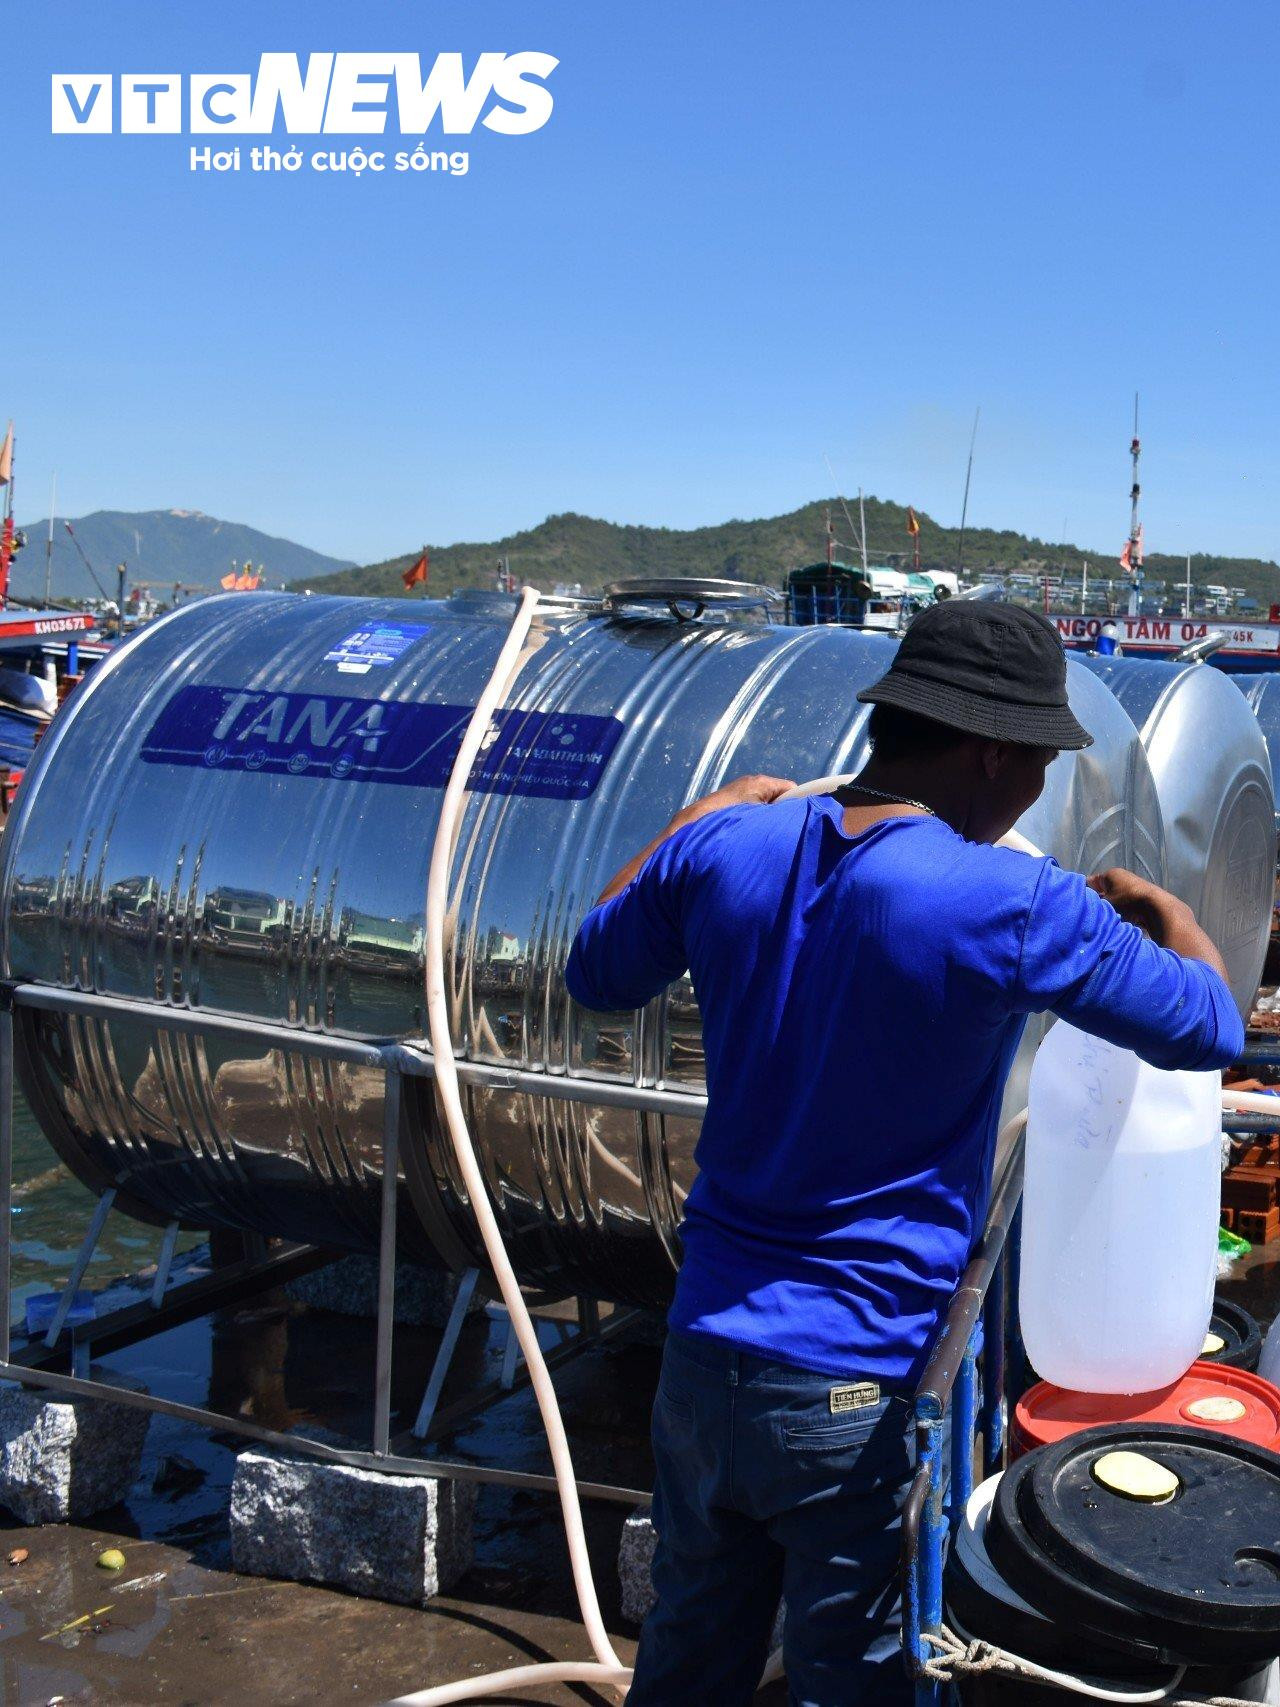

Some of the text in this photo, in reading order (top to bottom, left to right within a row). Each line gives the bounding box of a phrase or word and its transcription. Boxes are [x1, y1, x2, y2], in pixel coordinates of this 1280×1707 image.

[1124, 618, 1171, 640] TÂM
[1181, 622, 1208, 642] 04
[213, 692, 389, 752] TANA
